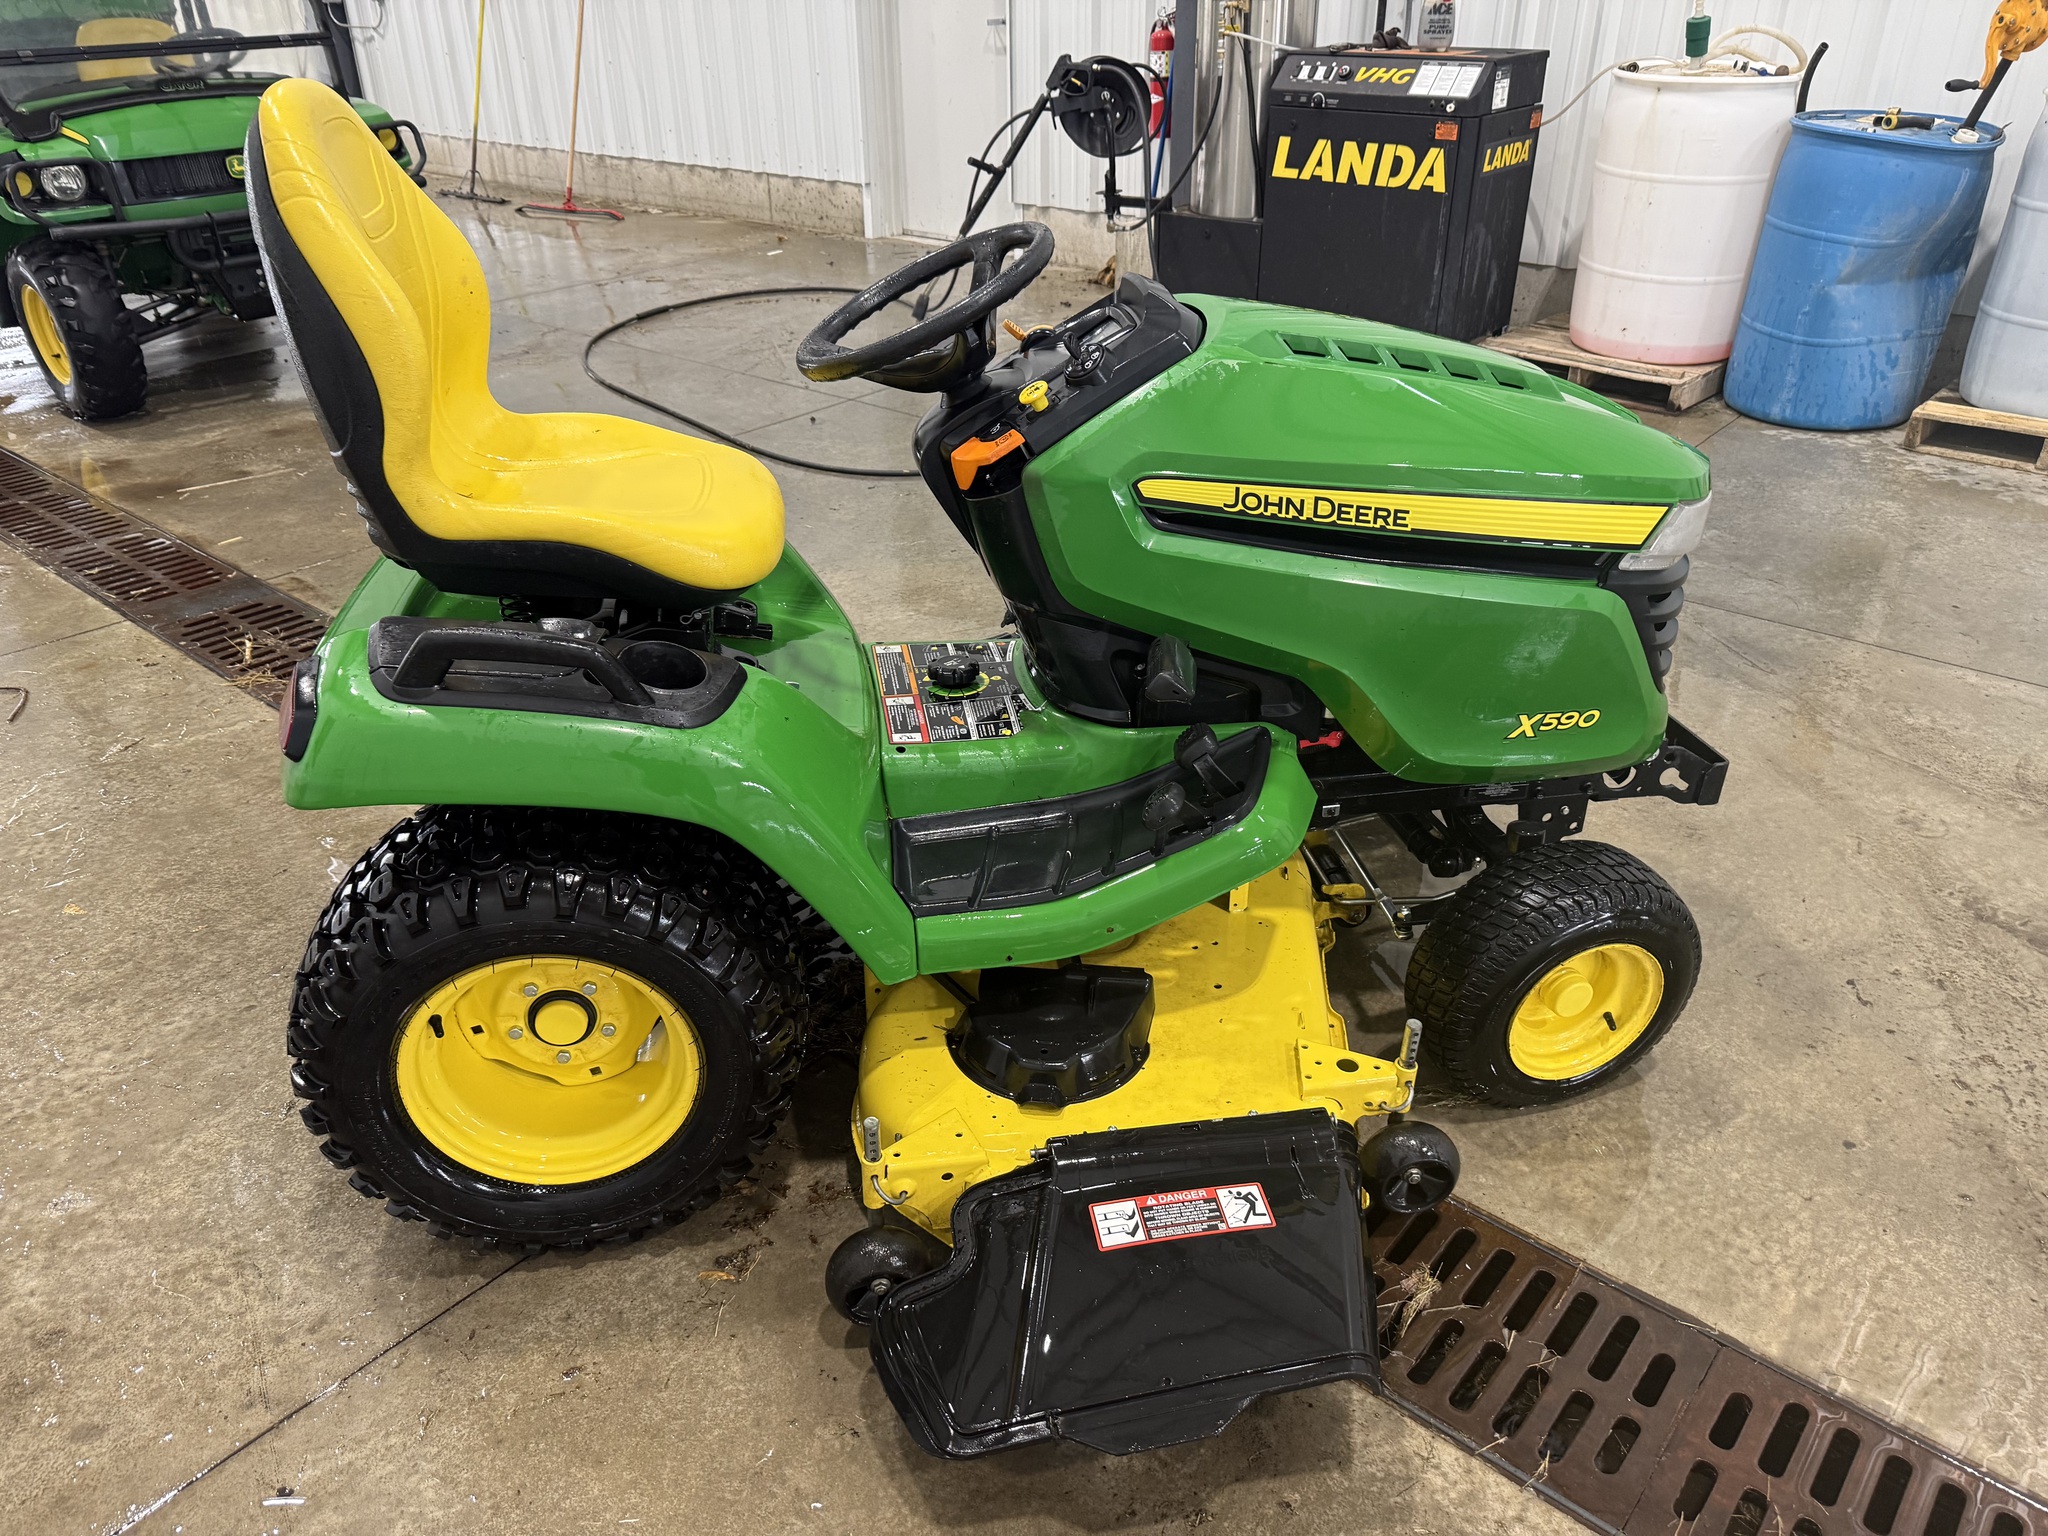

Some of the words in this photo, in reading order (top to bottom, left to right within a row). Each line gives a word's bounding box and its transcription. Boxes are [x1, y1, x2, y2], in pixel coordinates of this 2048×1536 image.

[1428, 3, 1453, 14] ACE
[160, 79, 205, 92] GATOR
[1354, 66, 1416, 85] VHG
[1271, 136, 1446, 193] LANDA
[1483, 140, 1532, 173] LANDA
[1223, 486, 1306, 519] JOHN
[1312, 495, 1411, 529] DEERE
[1504, 708, 1602, 739] X590
[1158, 1190, 1207, 1203] DANGER
